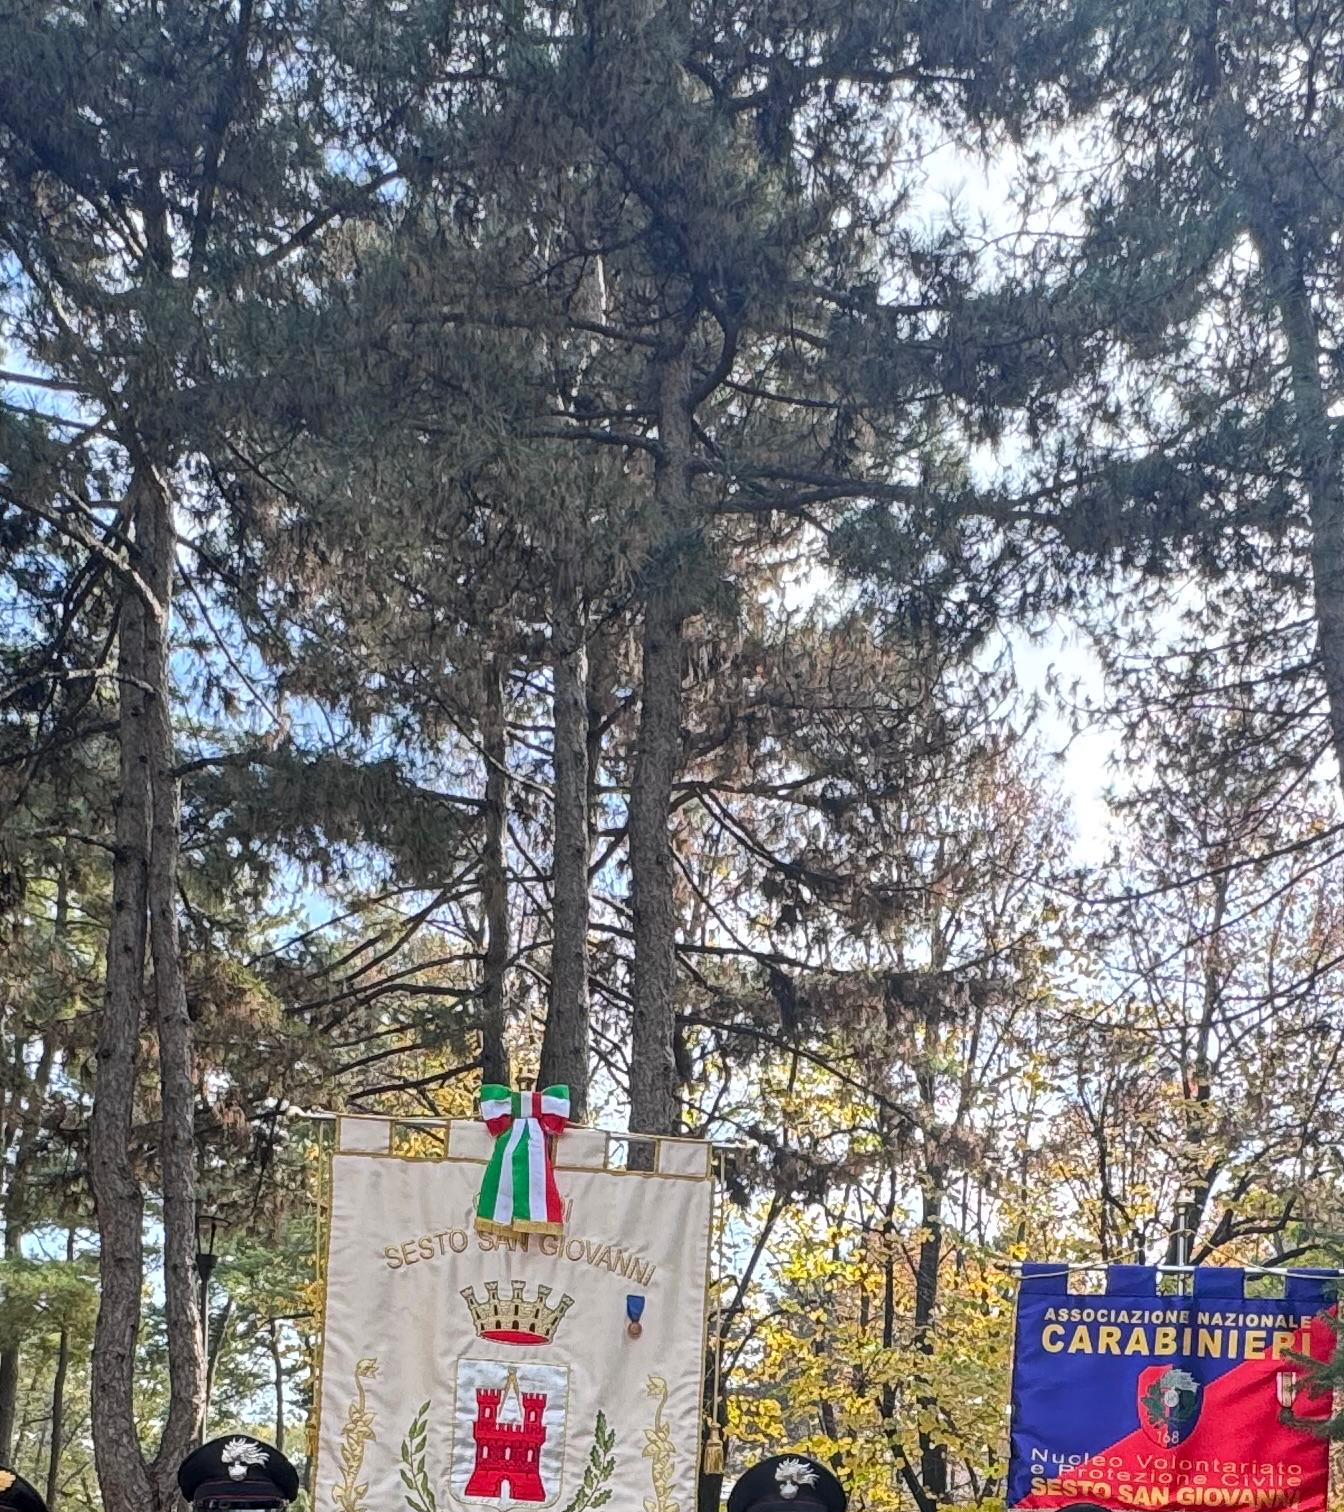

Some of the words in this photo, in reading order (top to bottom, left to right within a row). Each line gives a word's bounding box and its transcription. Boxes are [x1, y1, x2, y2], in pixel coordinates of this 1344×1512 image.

[384, 1228, 468, 1270] SESTO
[539, 1233, 656, 1287] GIOVANNI
[1044, 1307, 1189, 1325] ASSOCIAZIONE
[1197, 1311, 1312, 1330] NAZIONALE
[1041, 1324, 1311, 1361] CARABINIERI
[1156, 1430, 1180, 1444] 168
[1030, 1448, 1123, 1468] Nucleo
[1136, 1454, 1302, 1476] Volontariato
[1030, 1464, 1045, 1475] e
[1058, 1464, 1208, 1486] Protezione
[1220, 1472, 1302, 1488] Civile
[1030, 1477, 1112, 1499] SESTO
[1118, 1484, 1170, 1507] SAN
